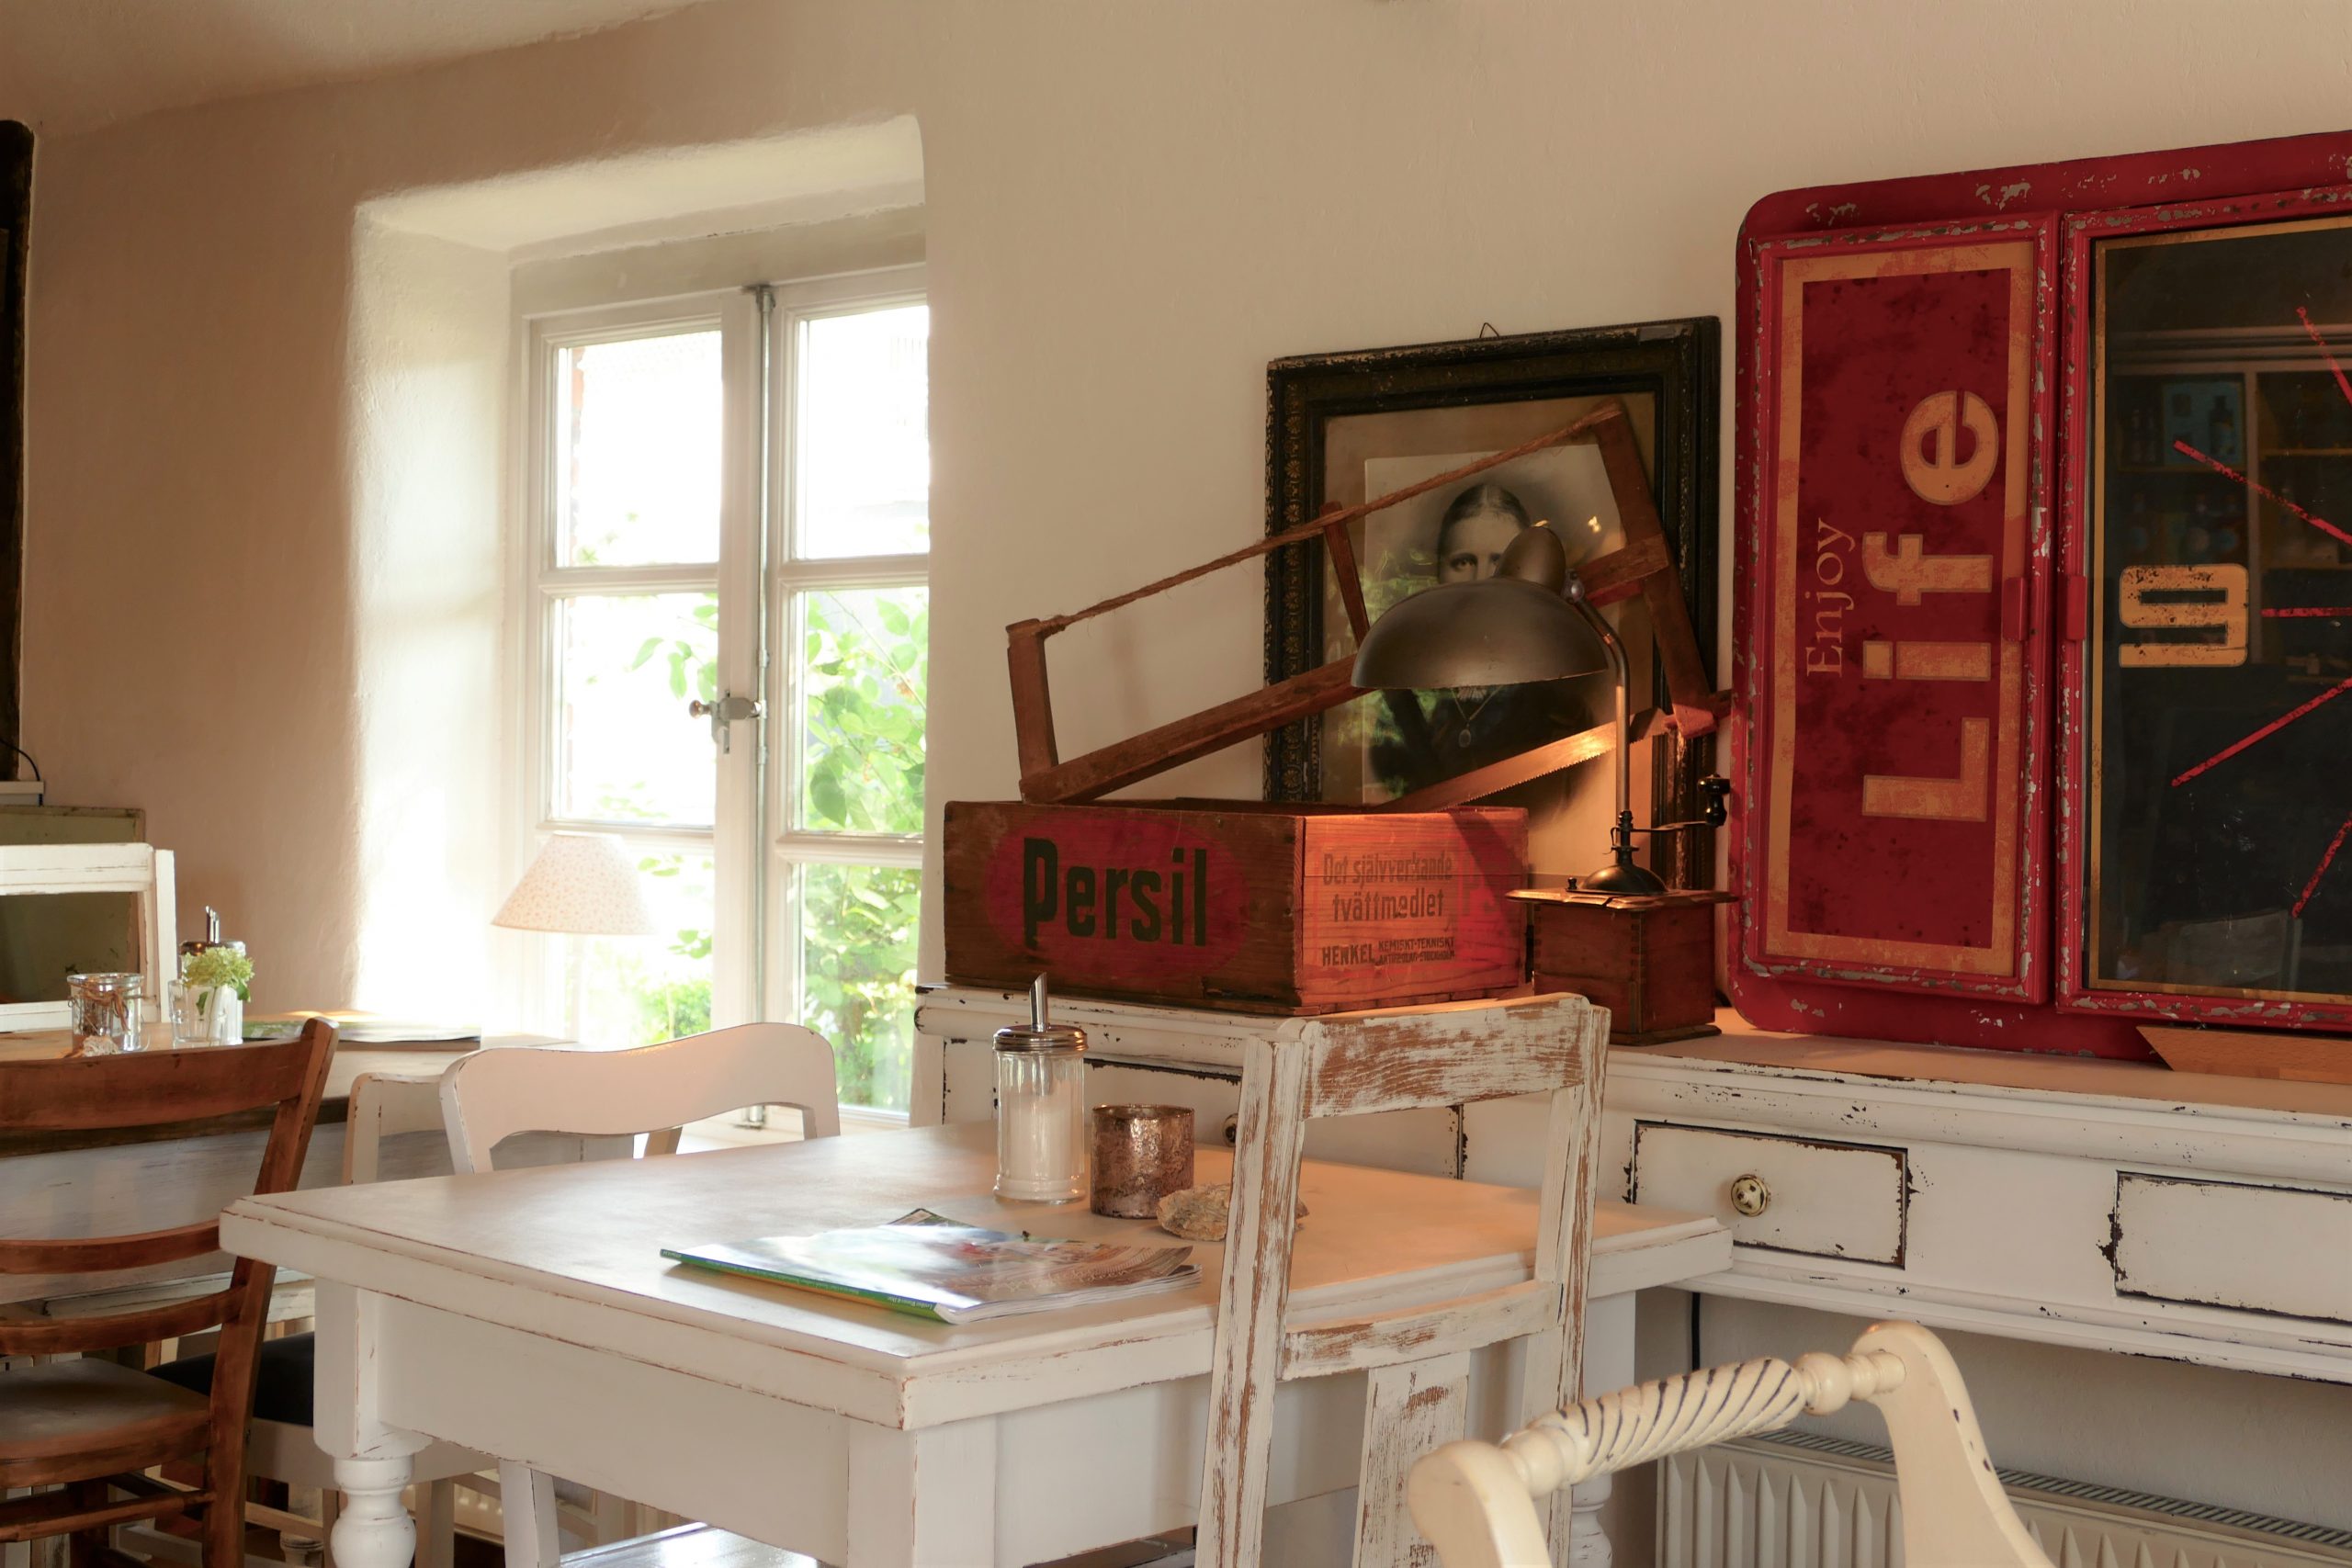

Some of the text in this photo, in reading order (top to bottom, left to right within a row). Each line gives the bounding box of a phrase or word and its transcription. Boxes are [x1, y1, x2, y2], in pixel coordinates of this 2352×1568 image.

[1805, 517, 1856, 678] Enjoy
[1861, 389, 2000, 823] Life
[2119, 563, 2249, 668] 9
[1023, 837, 1207, 952] Persil
[1323, 853, 1349, 886] Det
[1332, 887, 1444, 923] tvättmedlet
